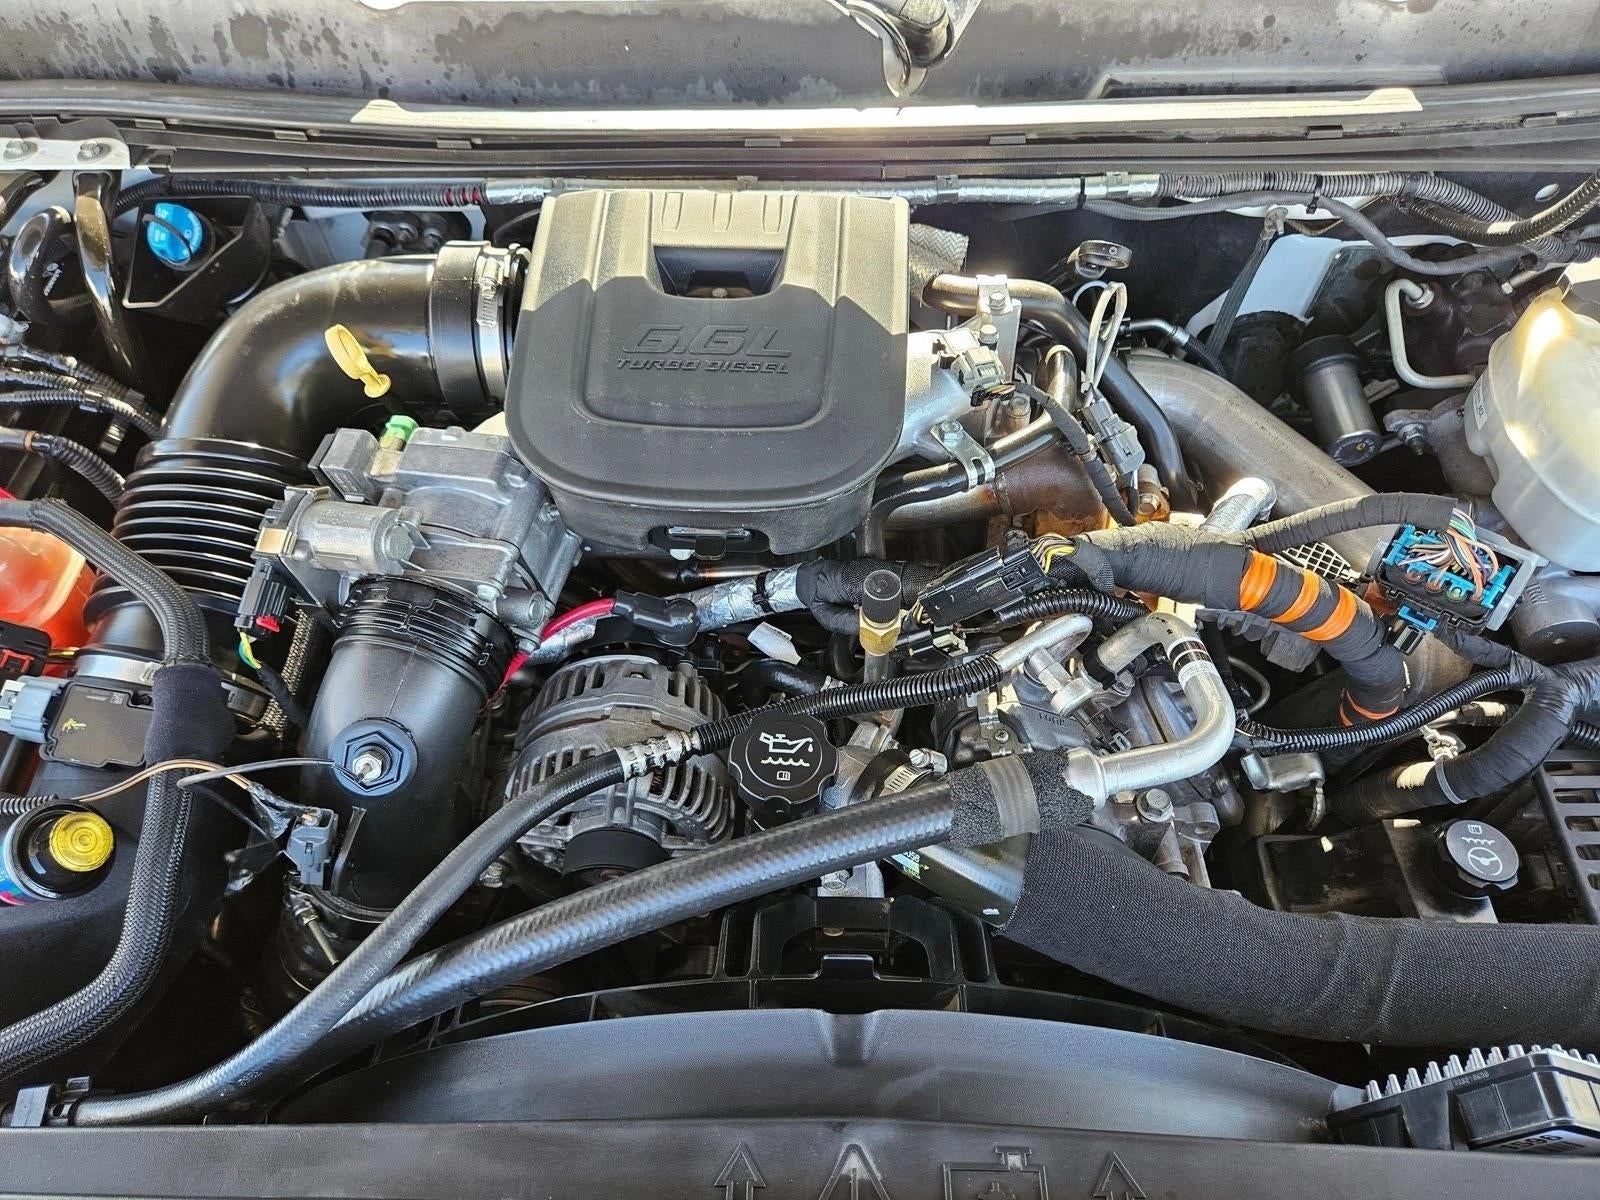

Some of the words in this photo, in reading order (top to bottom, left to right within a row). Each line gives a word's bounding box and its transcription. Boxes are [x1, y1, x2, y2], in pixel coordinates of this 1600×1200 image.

[622, 324, 792, 357] 6.6L
[617, 358, 700, 371] TURBO
[704, 359, 789, 374] DIESEL
